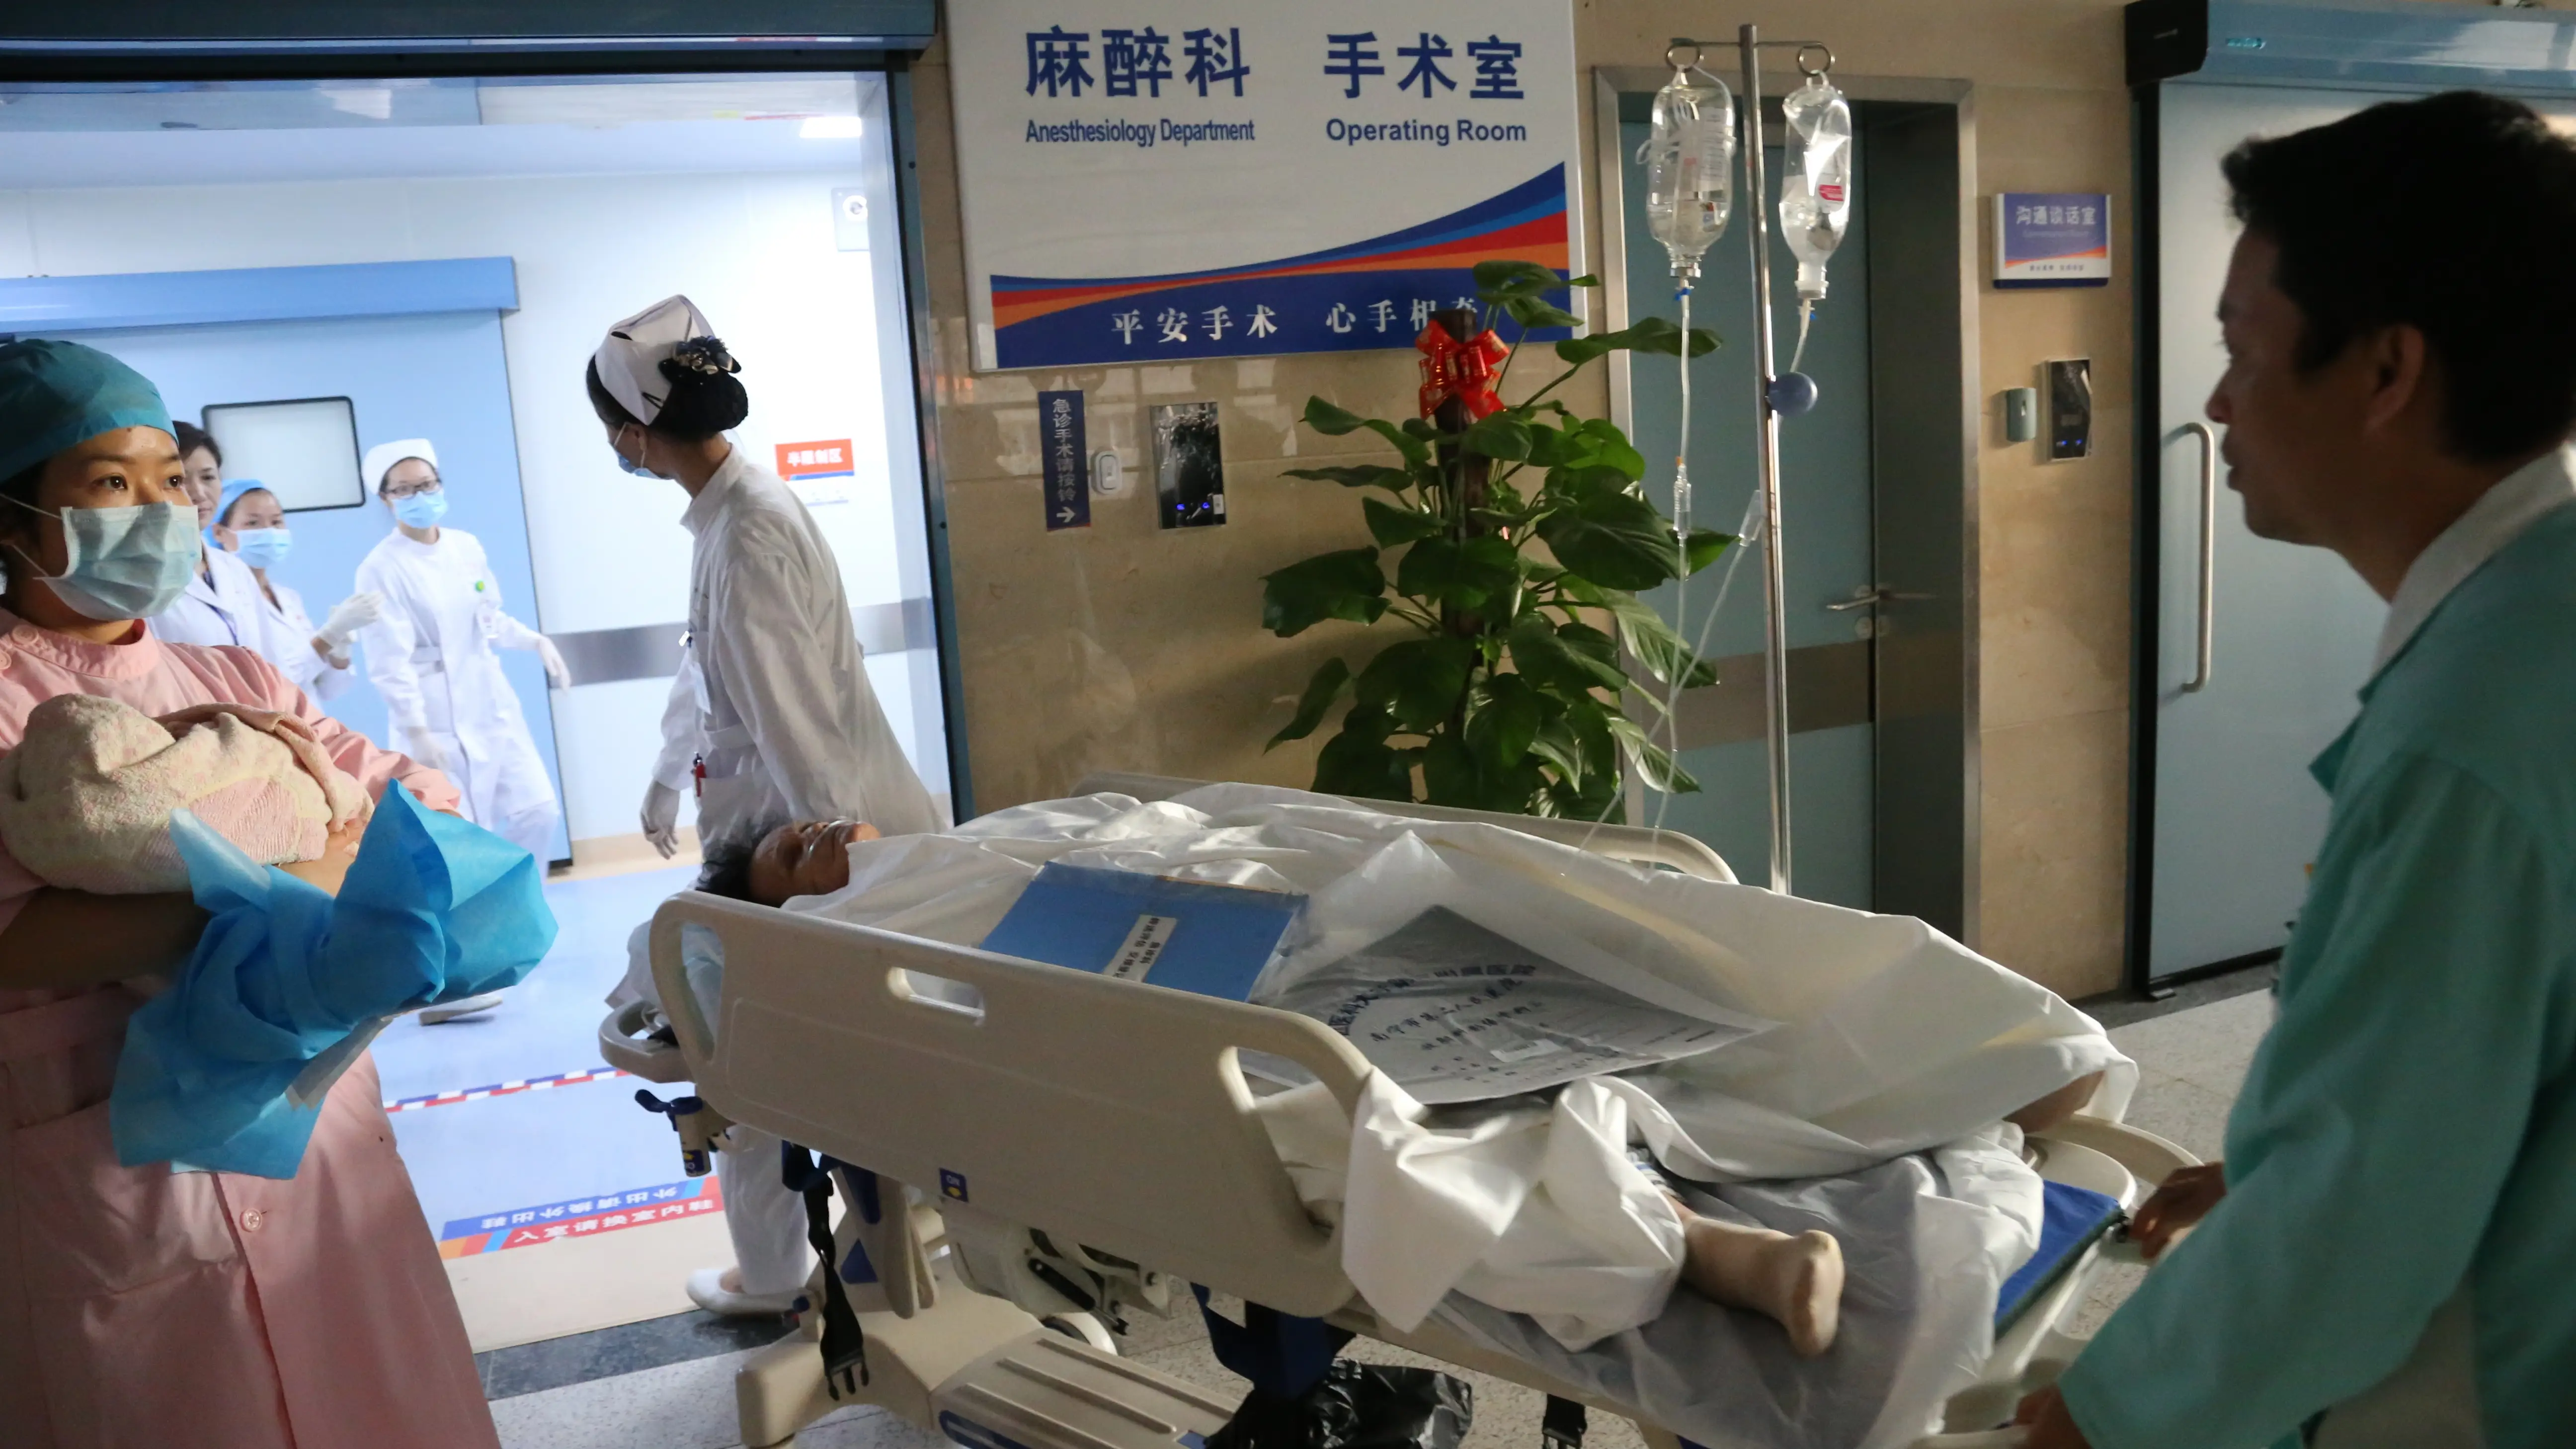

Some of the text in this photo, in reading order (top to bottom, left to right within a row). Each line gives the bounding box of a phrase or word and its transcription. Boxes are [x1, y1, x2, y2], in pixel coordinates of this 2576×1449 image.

[1026, 25, 1525, 99] 麻醉科 手术室
[1026, 118, 1256, 149] Anesthesiology Department
[1326, 118, 1528, 148] Operating Room
[1111, 303, 1279, 346] 平安手术
[1051, 398, 1077, 503] 急诊手术请按铃
